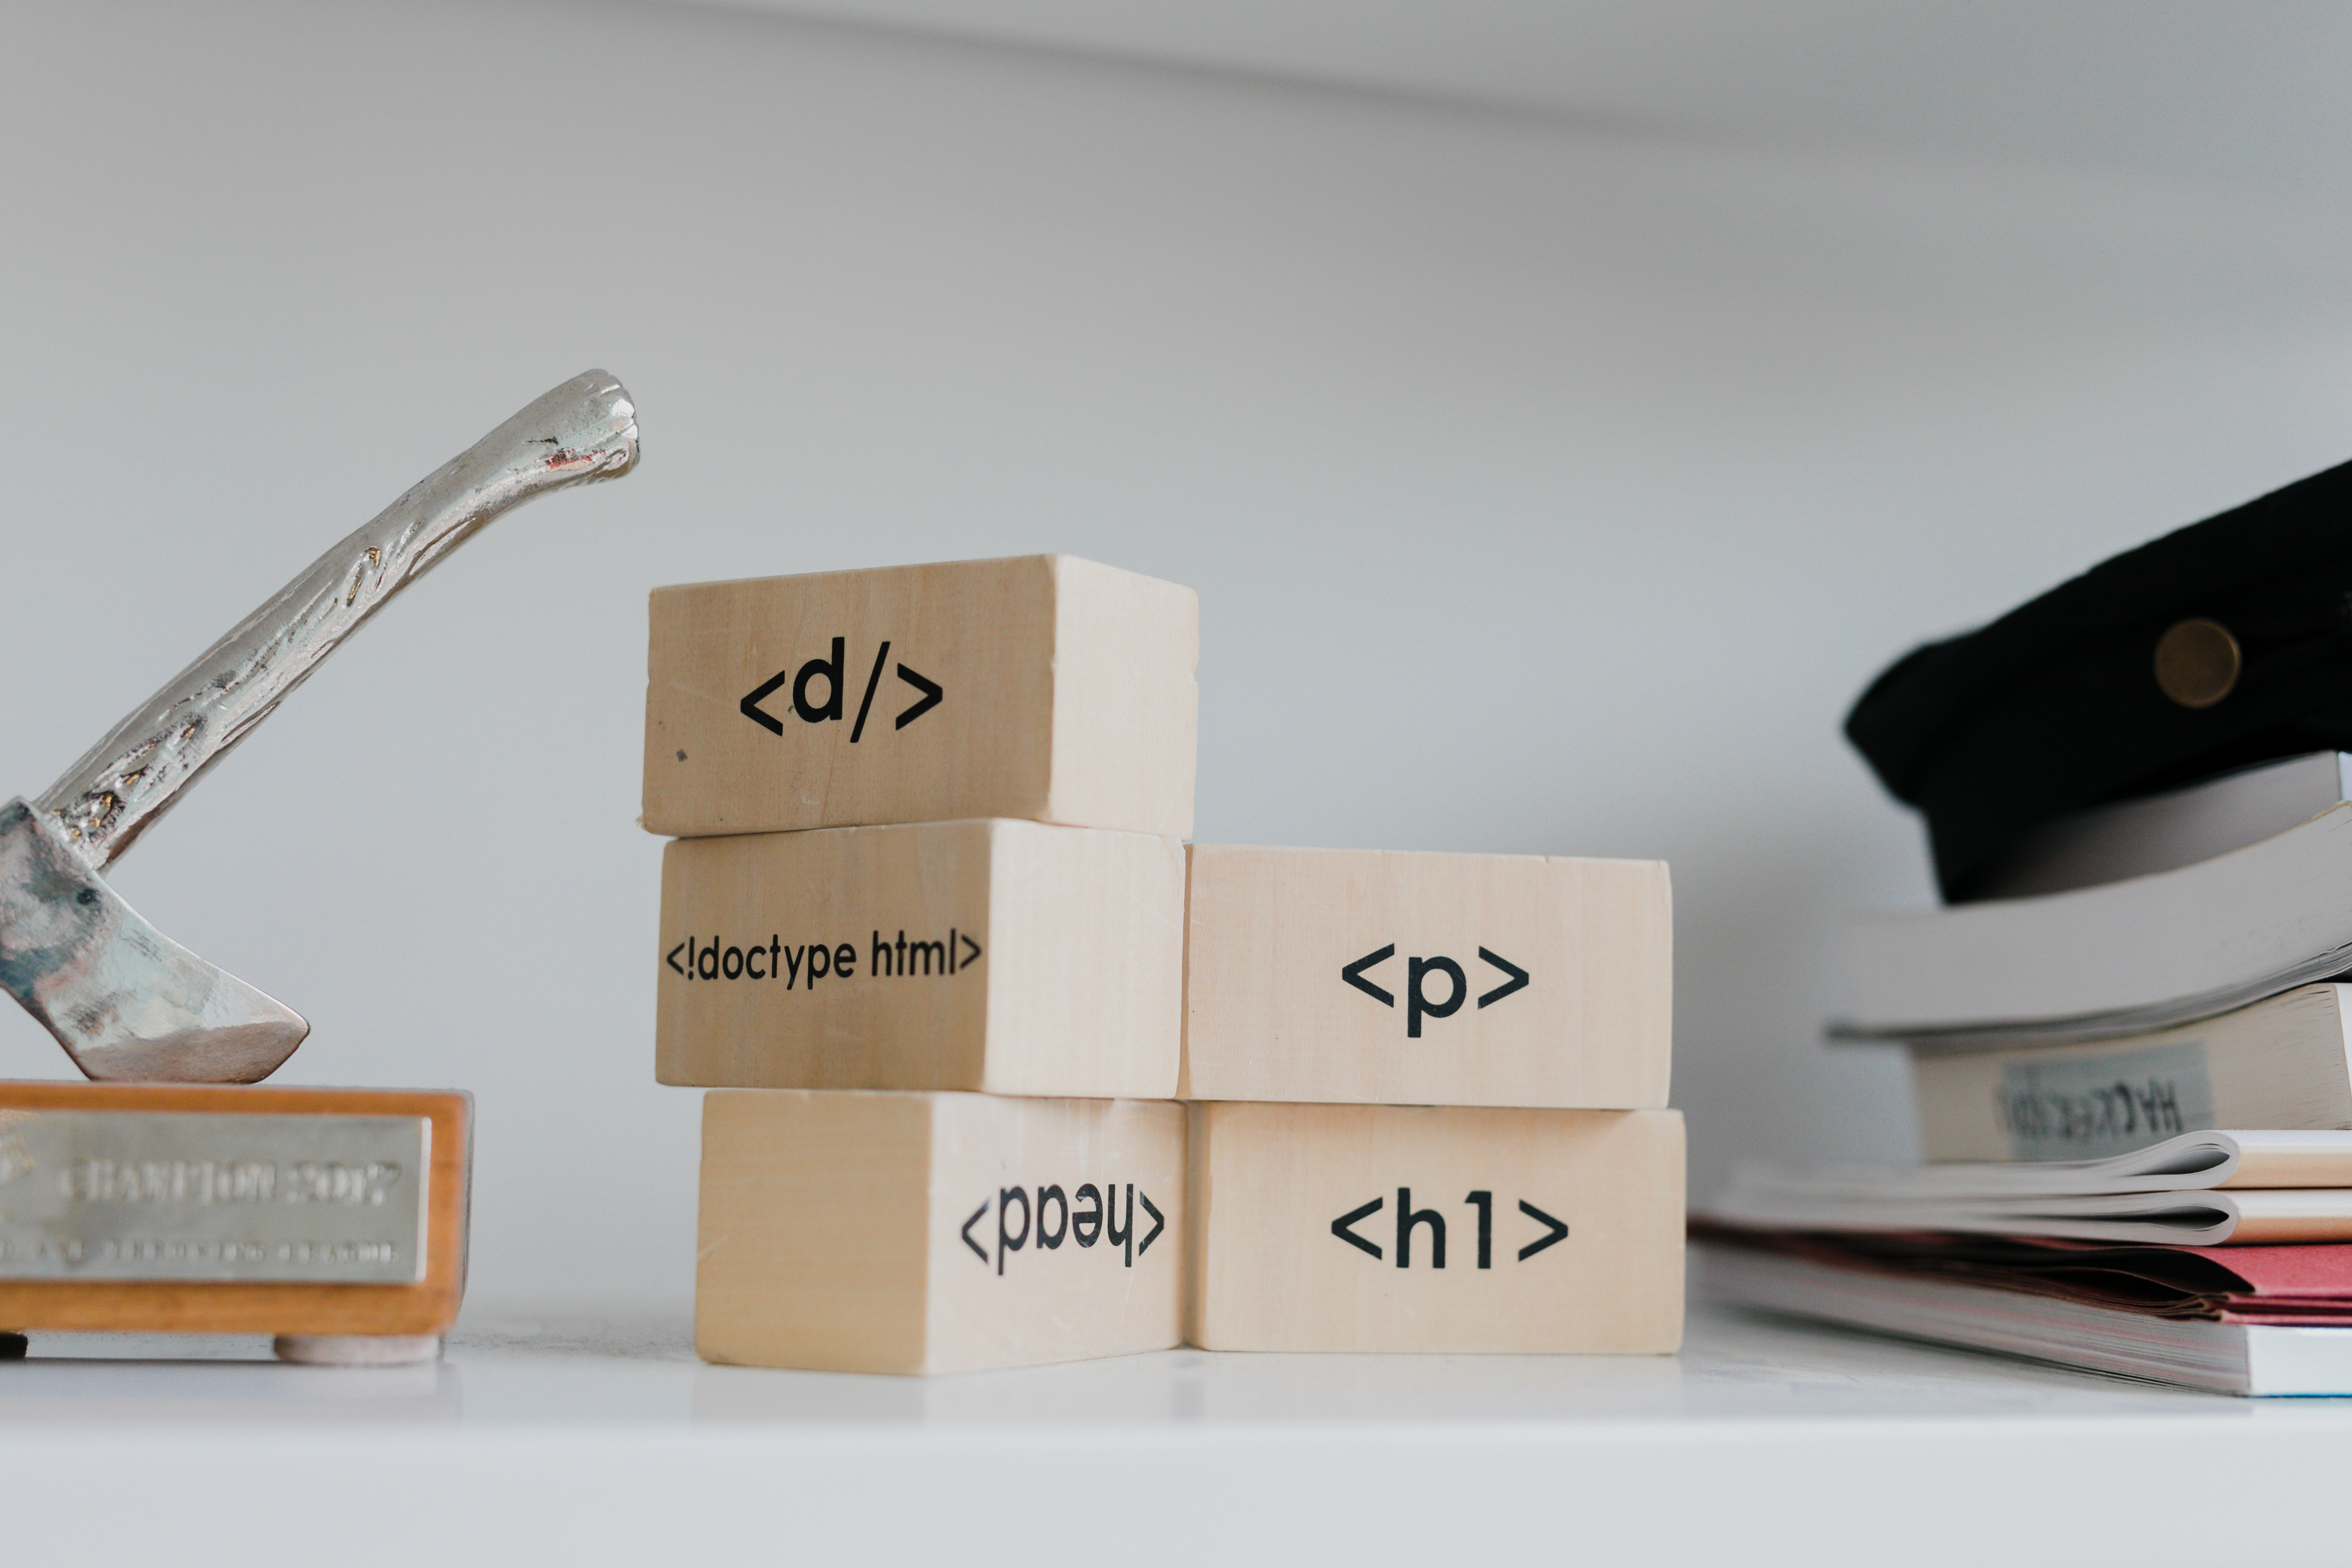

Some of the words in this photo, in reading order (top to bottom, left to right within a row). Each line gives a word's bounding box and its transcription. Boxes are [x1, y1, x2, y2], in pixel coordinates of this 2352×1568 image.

[739, 636, 944, 744] <d/>
[665, 933, 857, 991] <!doctype
[870, 927, 983, 978] html>
[1341, 943, 1530, 1038] <p>
[961, 1183, 1165, 1276] <head>
[1330, 1187, 1569, 1270] <h1>
